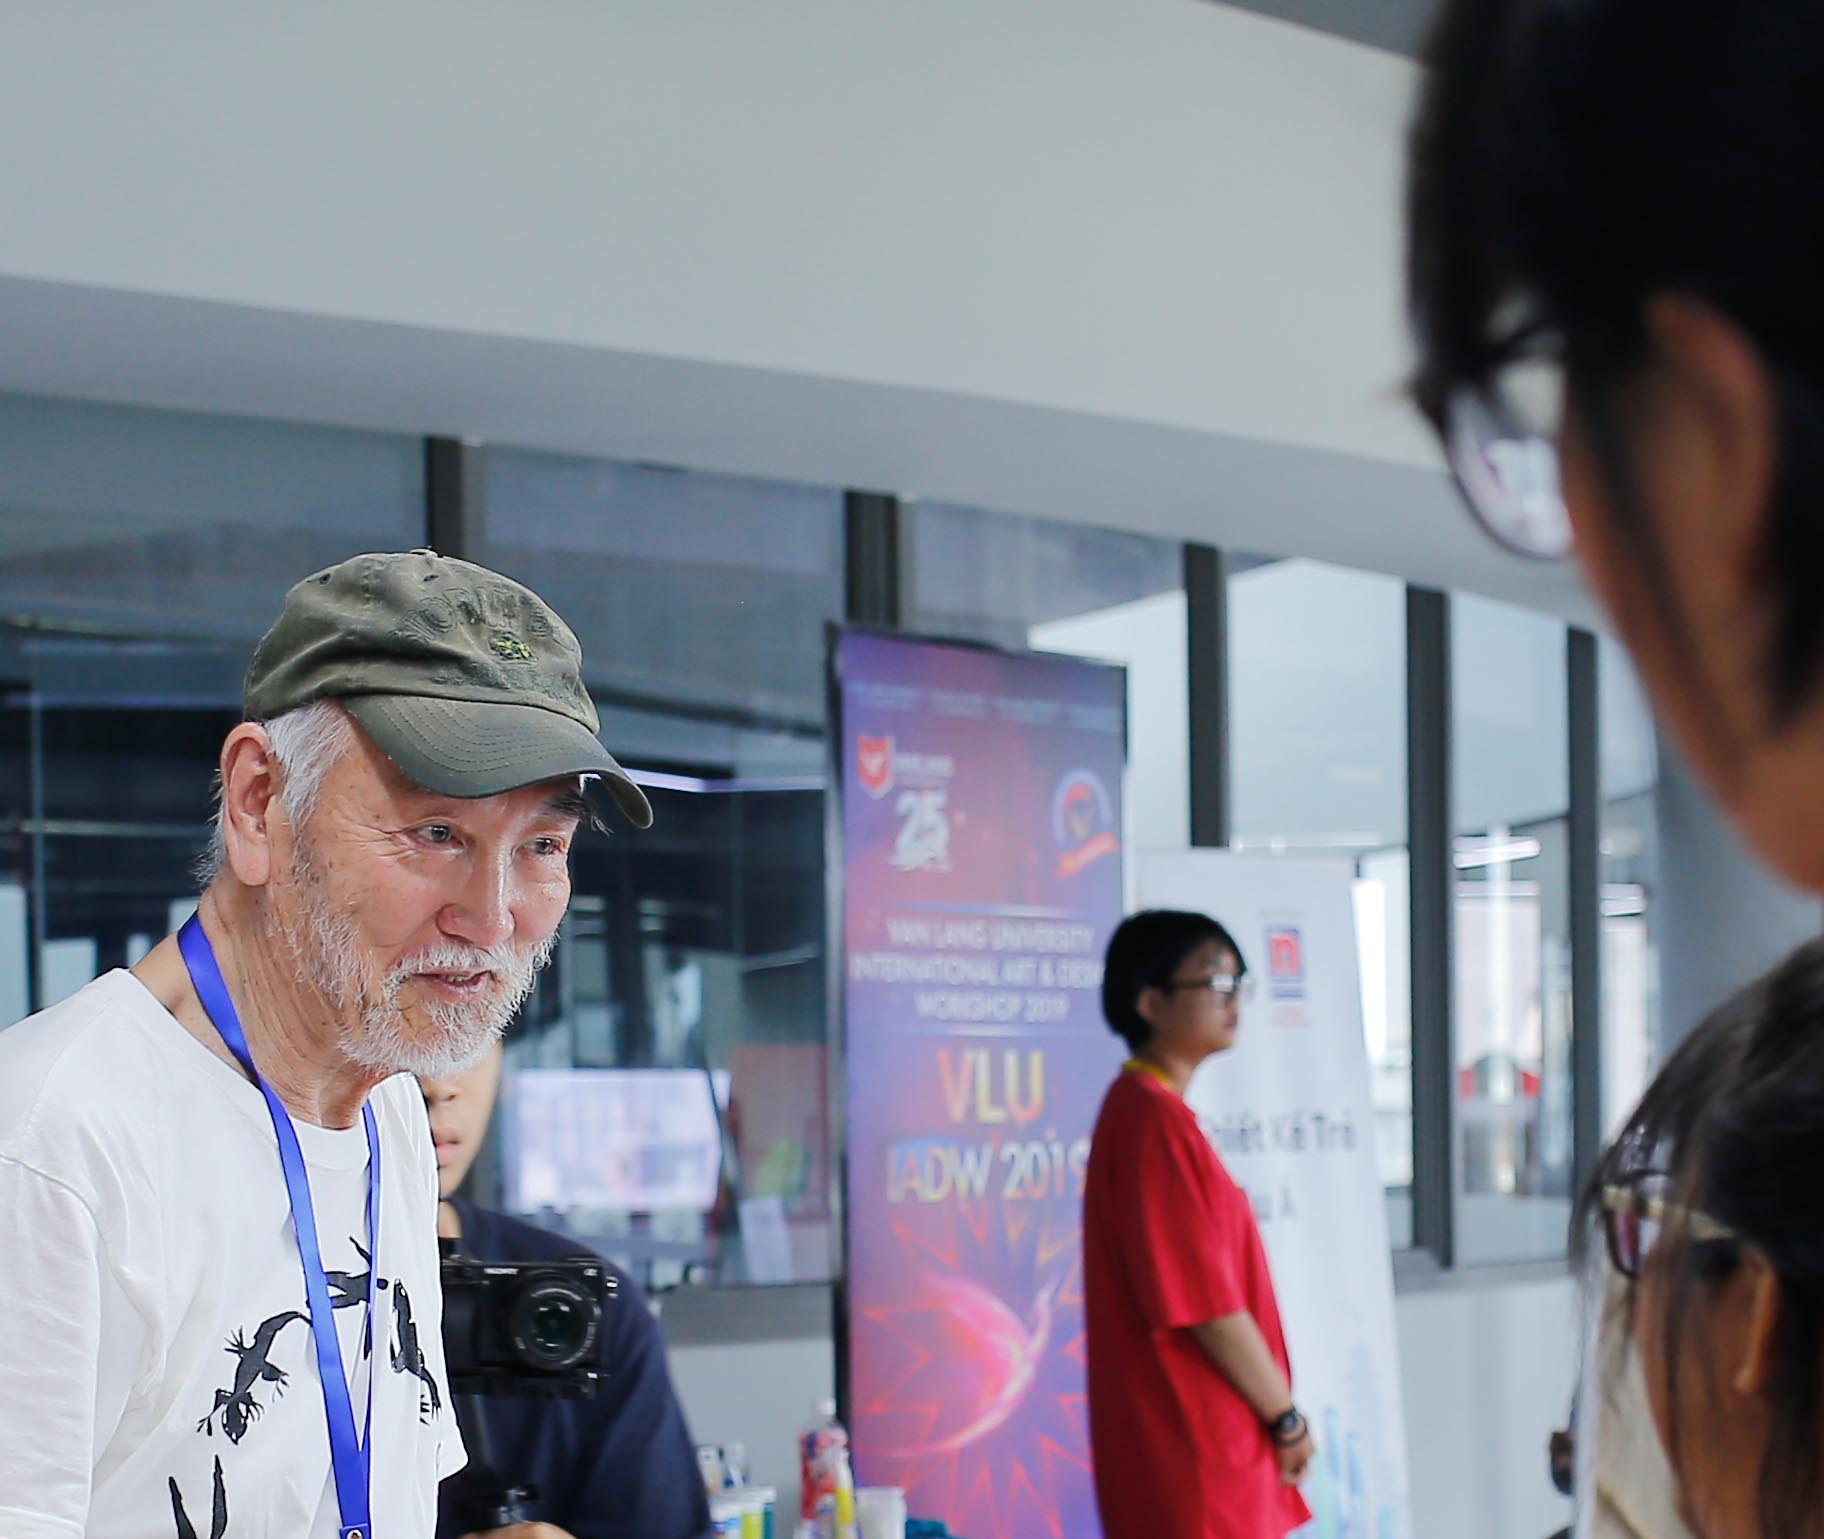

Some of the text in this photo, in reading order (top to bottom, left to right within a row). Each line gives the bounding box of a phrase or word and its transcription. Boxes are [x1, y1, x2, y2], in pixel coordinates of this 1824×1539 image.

[887, 919, 1095, 953] VAN LANG UNIVERSITY
[848, 953, 999, 986] INTERNATIONAL
[1001, 957, 1037, 987] ART
[1058, 960, 1105, 989] DESI
[914, 991, 1070, 1023] WORKSHOP 2019
[937, 1048, 1044, 1124] VLU
